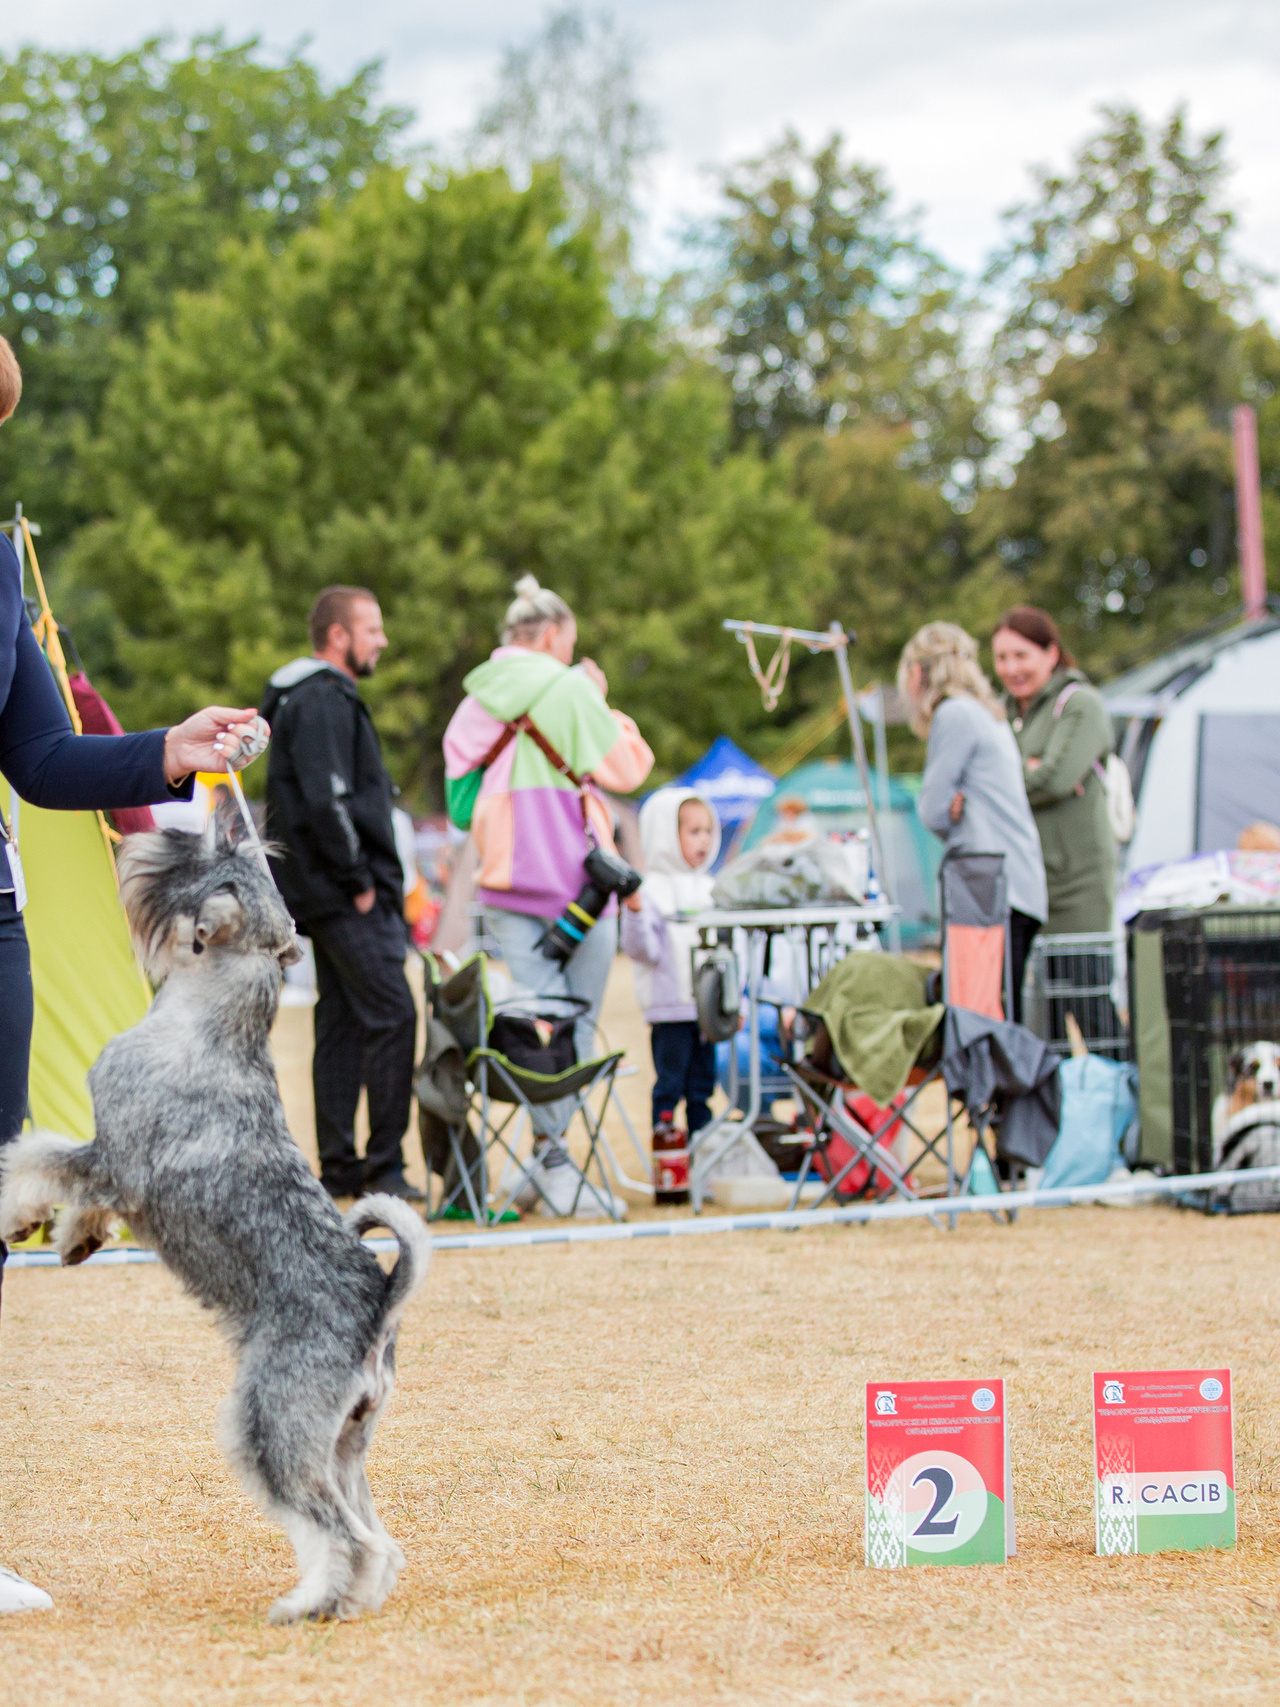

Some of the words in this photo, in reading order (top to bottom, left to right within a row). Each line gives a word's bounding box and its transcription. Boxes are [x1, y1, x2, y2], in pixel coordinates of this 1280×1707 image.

[911, 1467, 960, 1536] 2
[1113, 1486, 1131, 1504] R.
[1141, 1483, 1220, 1504] CACIB
